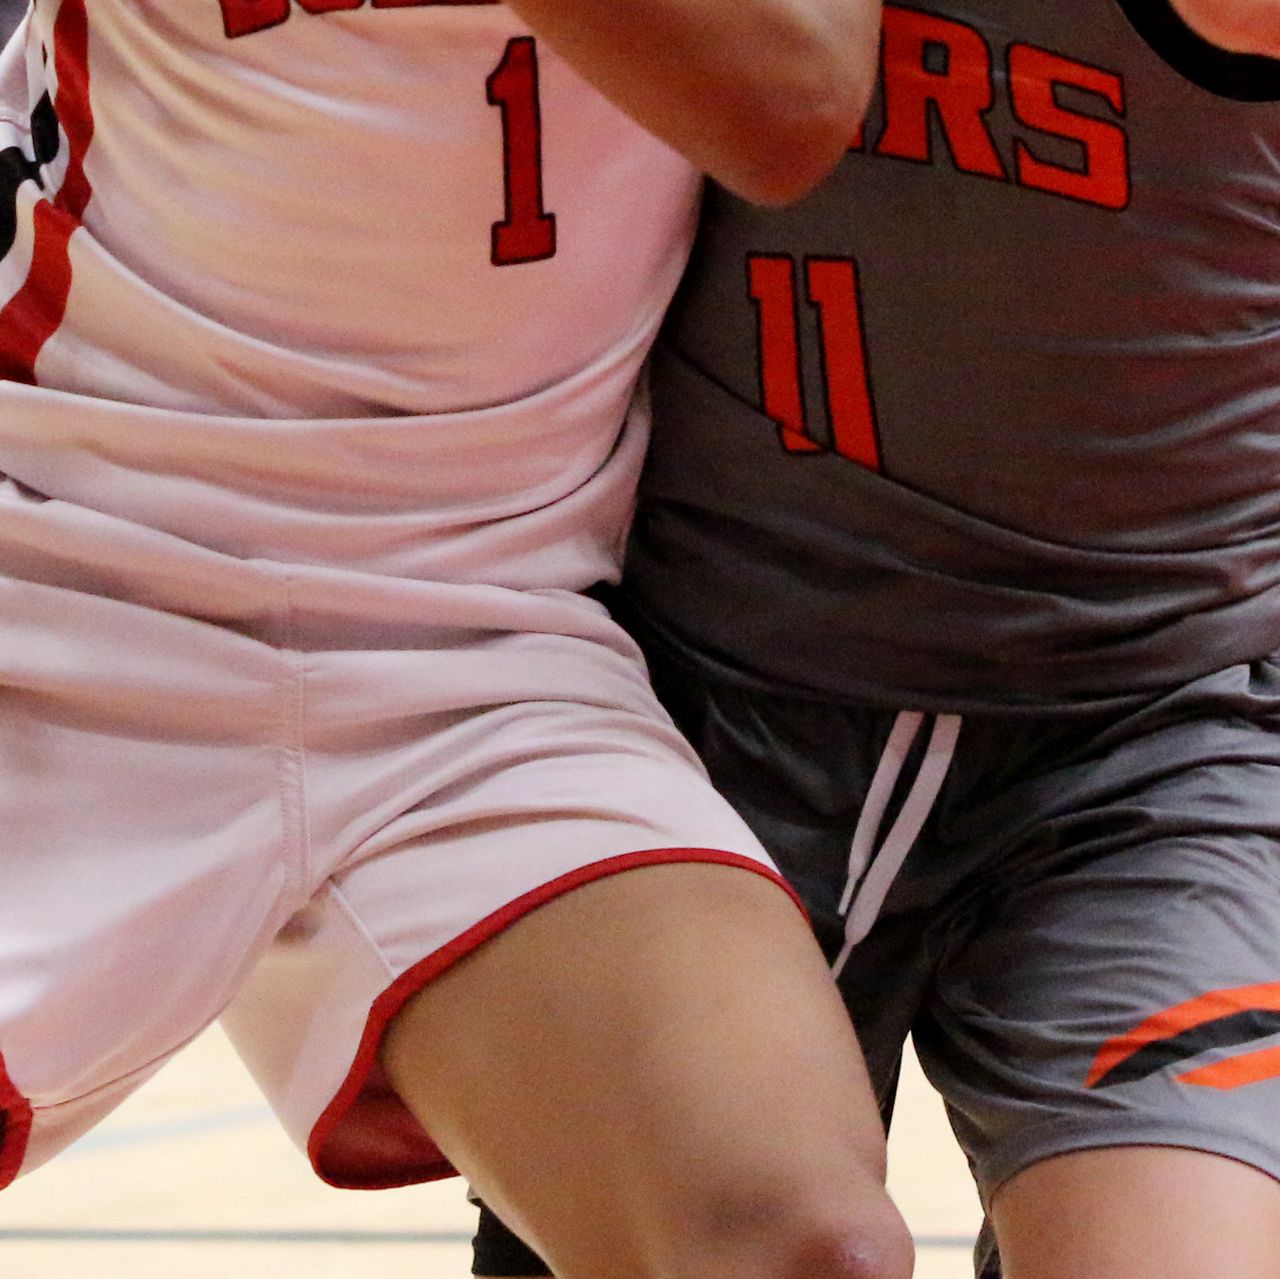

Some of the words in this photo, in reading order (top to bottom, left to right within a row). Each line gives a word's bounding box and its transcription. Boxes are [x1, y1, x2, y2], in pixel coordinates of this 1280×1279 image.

[486, 36, 556, 266] 1
[847, 1, 1133, 211] RS
[746, 252, 884, 473] 11
